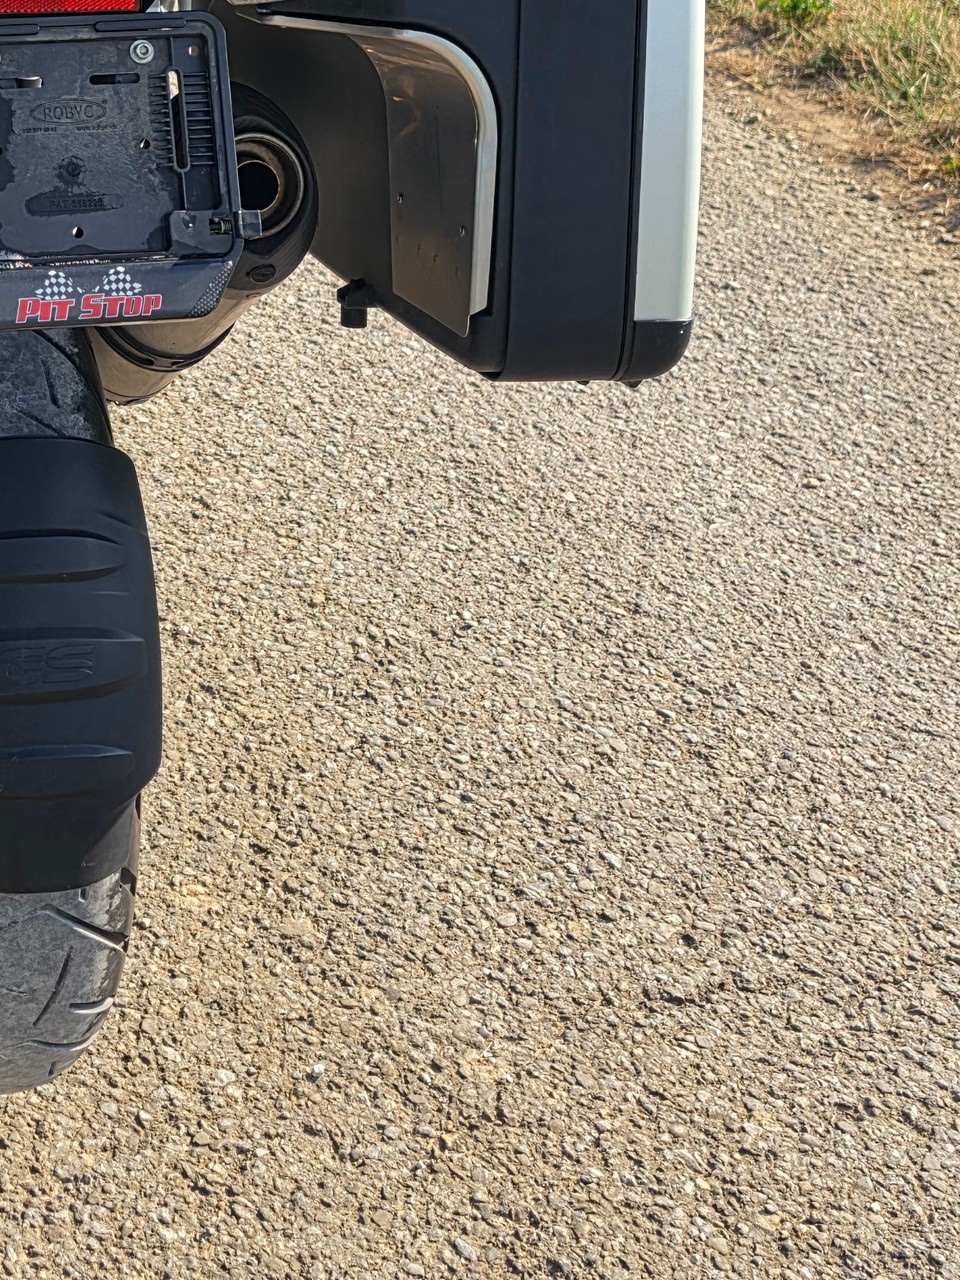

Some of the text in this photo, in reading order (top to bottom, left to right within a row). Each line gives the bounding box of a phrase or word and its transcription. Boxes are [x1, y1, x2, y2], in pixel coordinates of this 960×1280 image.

[43, 104, 95, 120] ROBYC
[15, 293, 162, 324] PIT STOP
